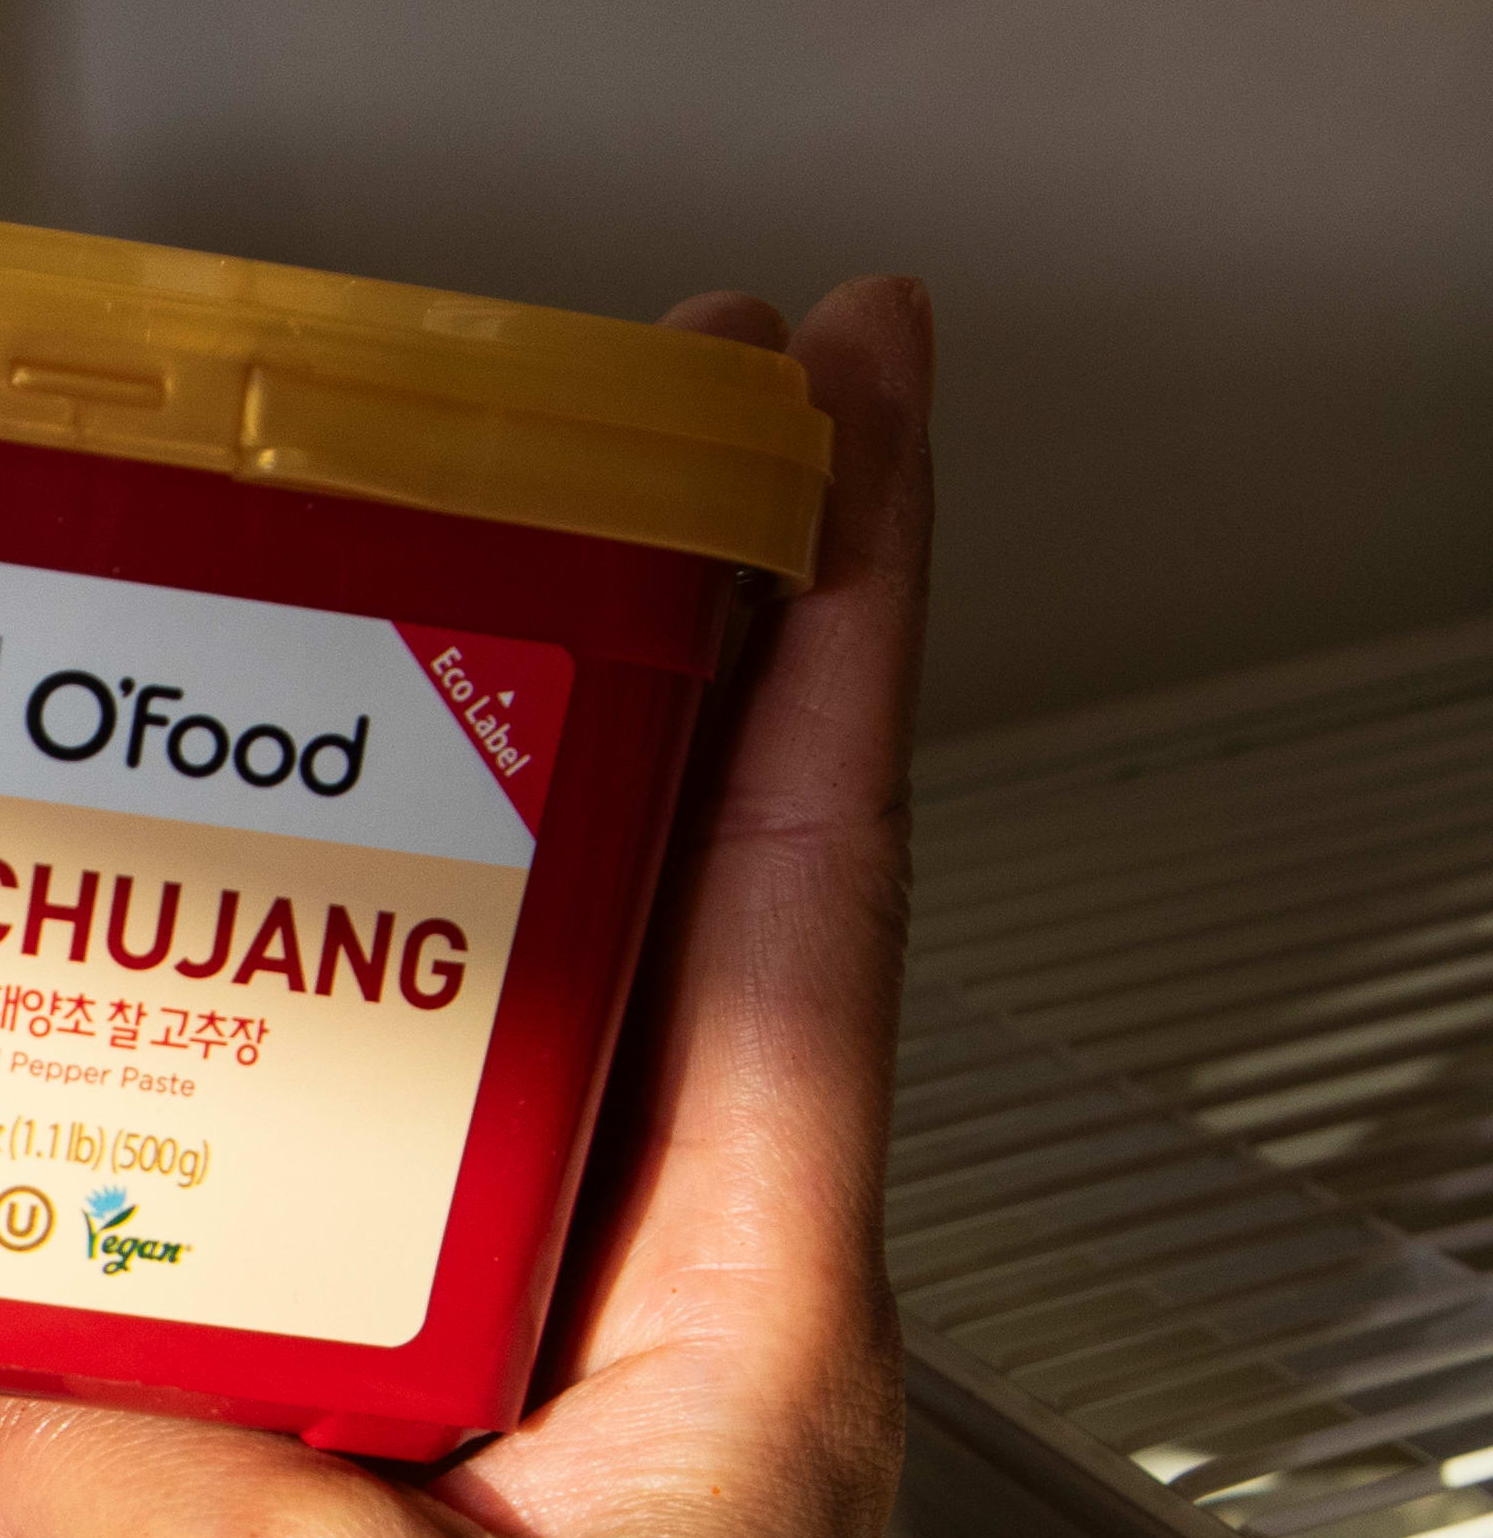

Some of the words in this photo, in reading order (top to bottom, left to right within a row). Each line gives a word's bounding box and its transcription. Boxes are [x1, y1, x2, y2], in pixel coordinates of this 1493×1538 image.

[430, 645, 474, 703] Eco
[464, 694, 531, 778] Label
[107, 997, 148, 1051] 찰
[149, 1006, 270, 1066] 고추장
[9, 1050, 112, 1085] Pepper
[120, 1065, 197, 1098] Paste
[111, 1129, 210, 1189] (500g)
